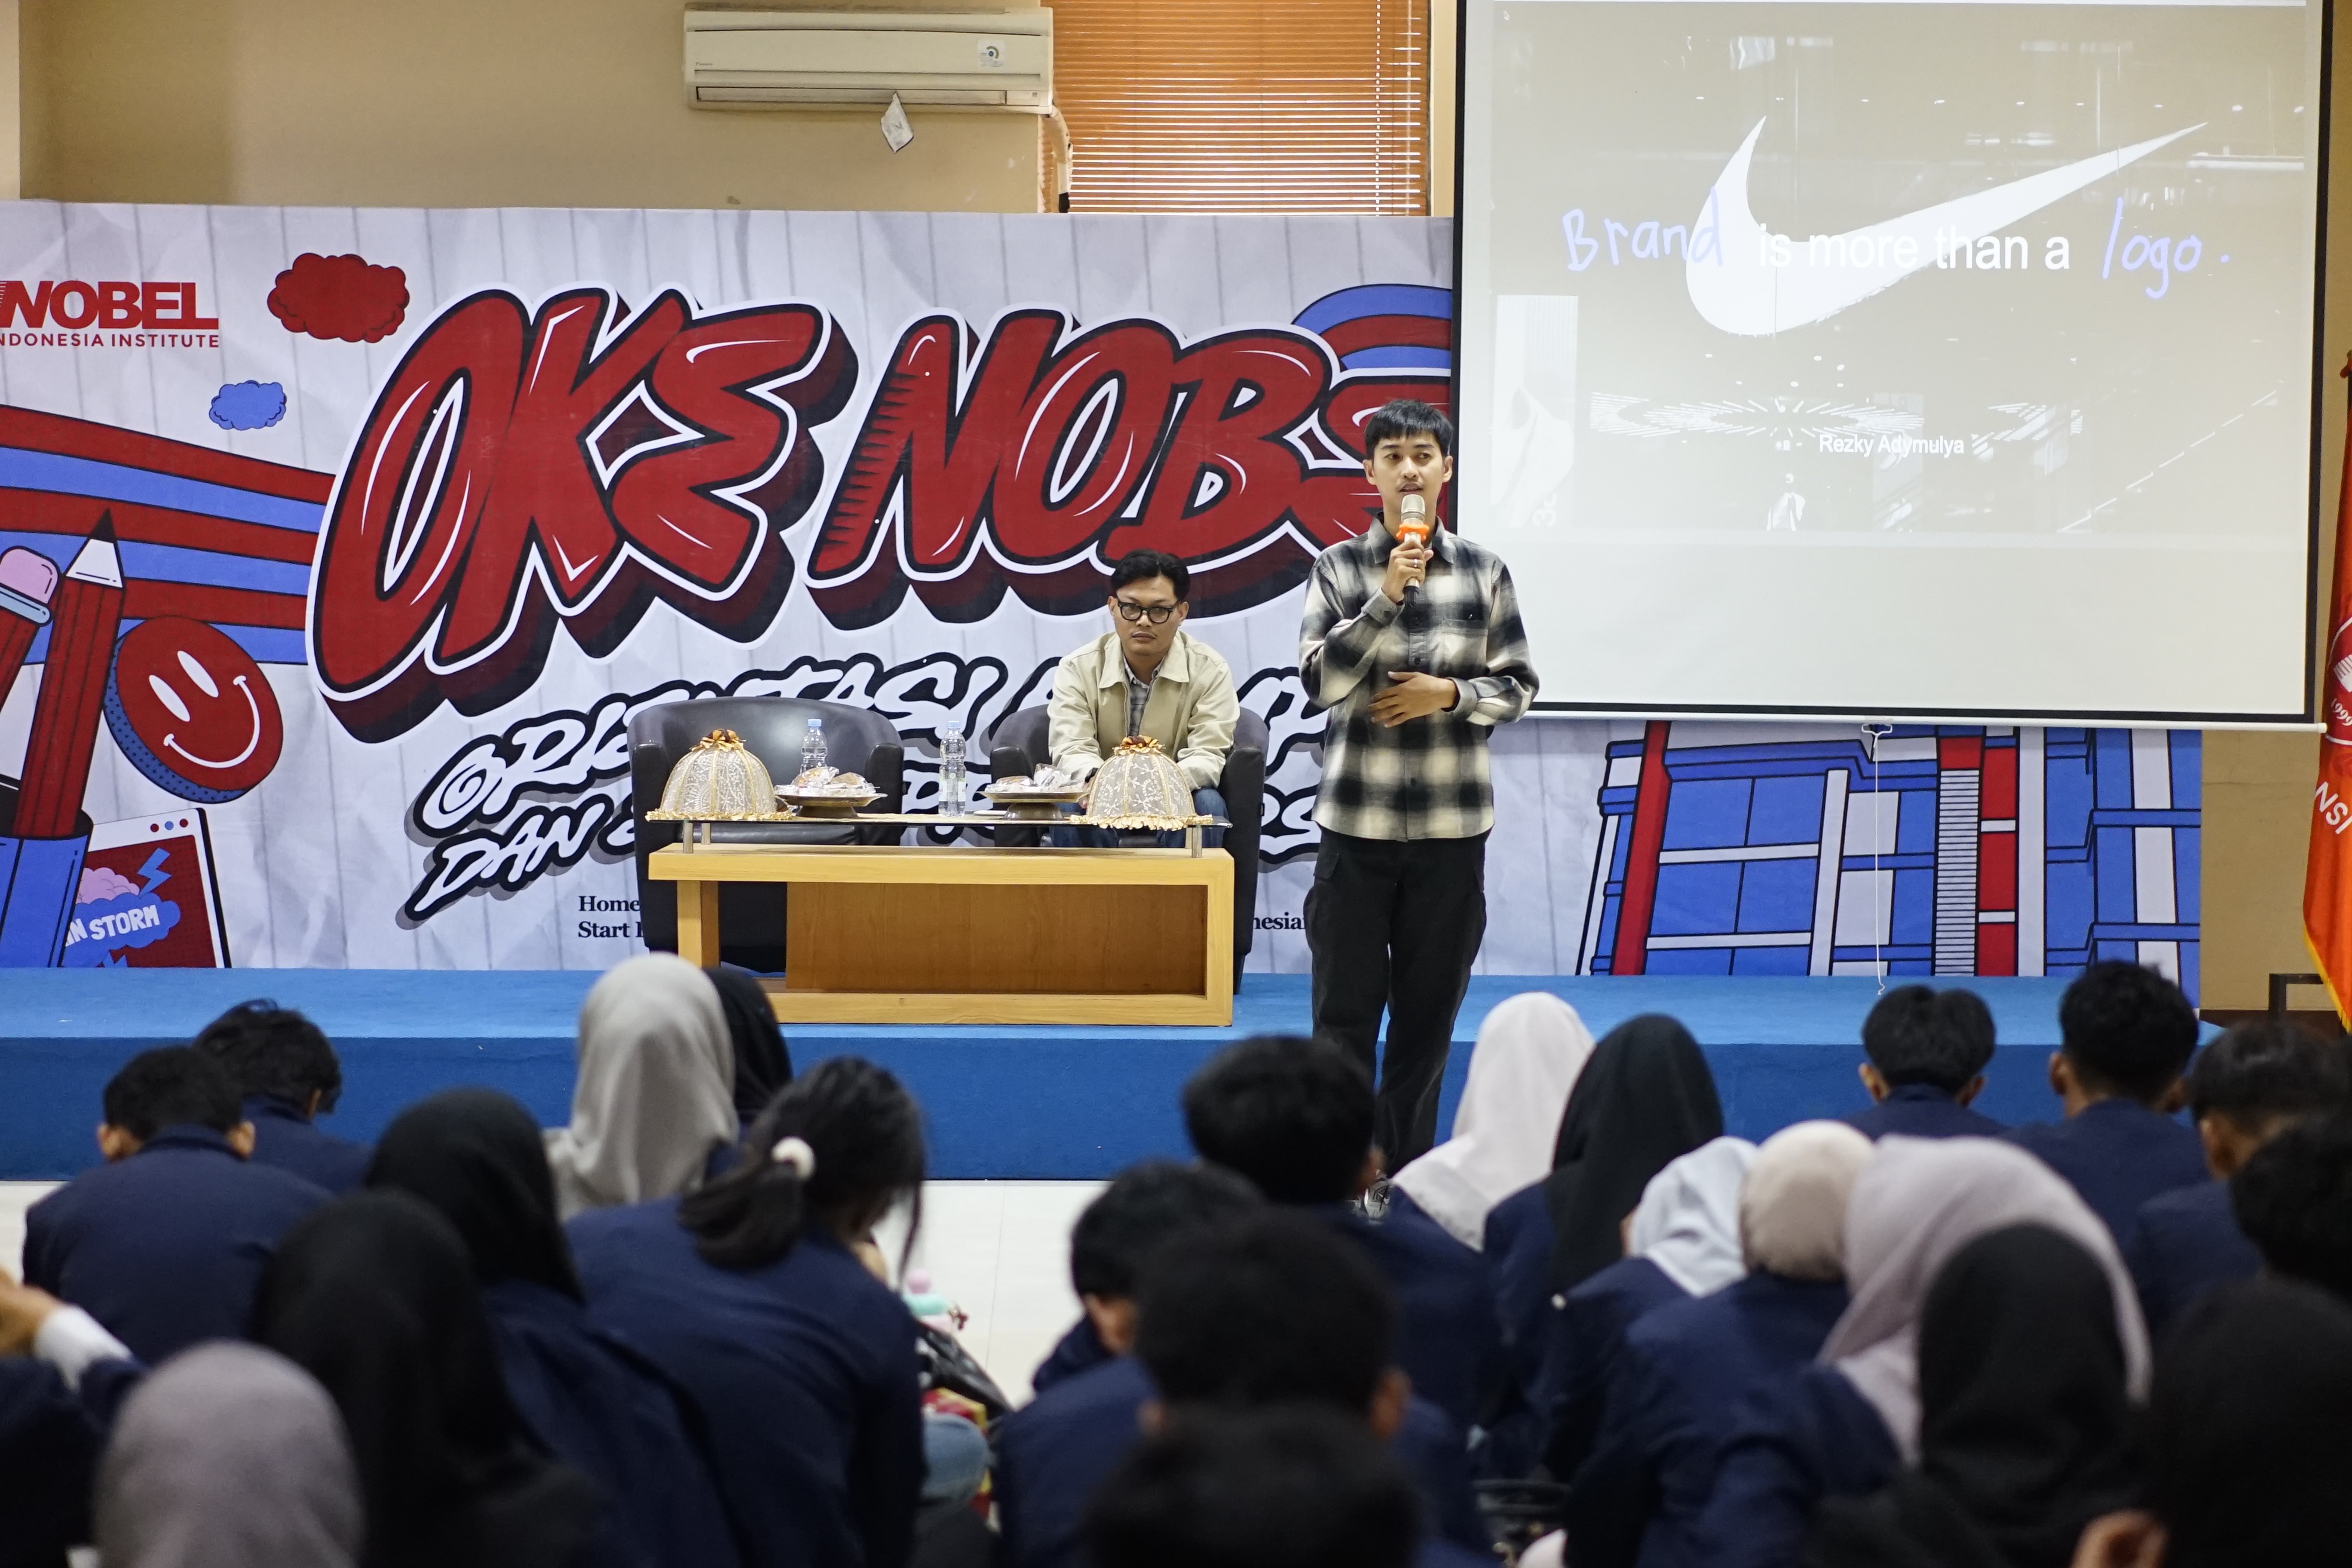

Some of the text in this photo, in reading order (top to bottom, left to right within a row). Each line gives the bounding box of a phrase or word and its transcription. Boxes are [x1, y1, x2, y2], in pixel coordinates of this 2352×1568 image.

[1561, 186, 1723, 272] Brand
[1759, 223, 1792, 267] is
[1808, 234, 1919, 268] more
[1934, 225, 2029, 270] than
[2044, 235, 2070, 270] a
[0, 280, 219, 330] NOBEL
[111, 333, 219, 348] INSTITUTE
[1820, 434, 1965, 458] Rezky Adymulya
[310, 283, 832, 700] OKE
[405, 794, 615, 921] DAN
[89, 904, 161, 941] STORM
[578, 921, 630, 938] Start
